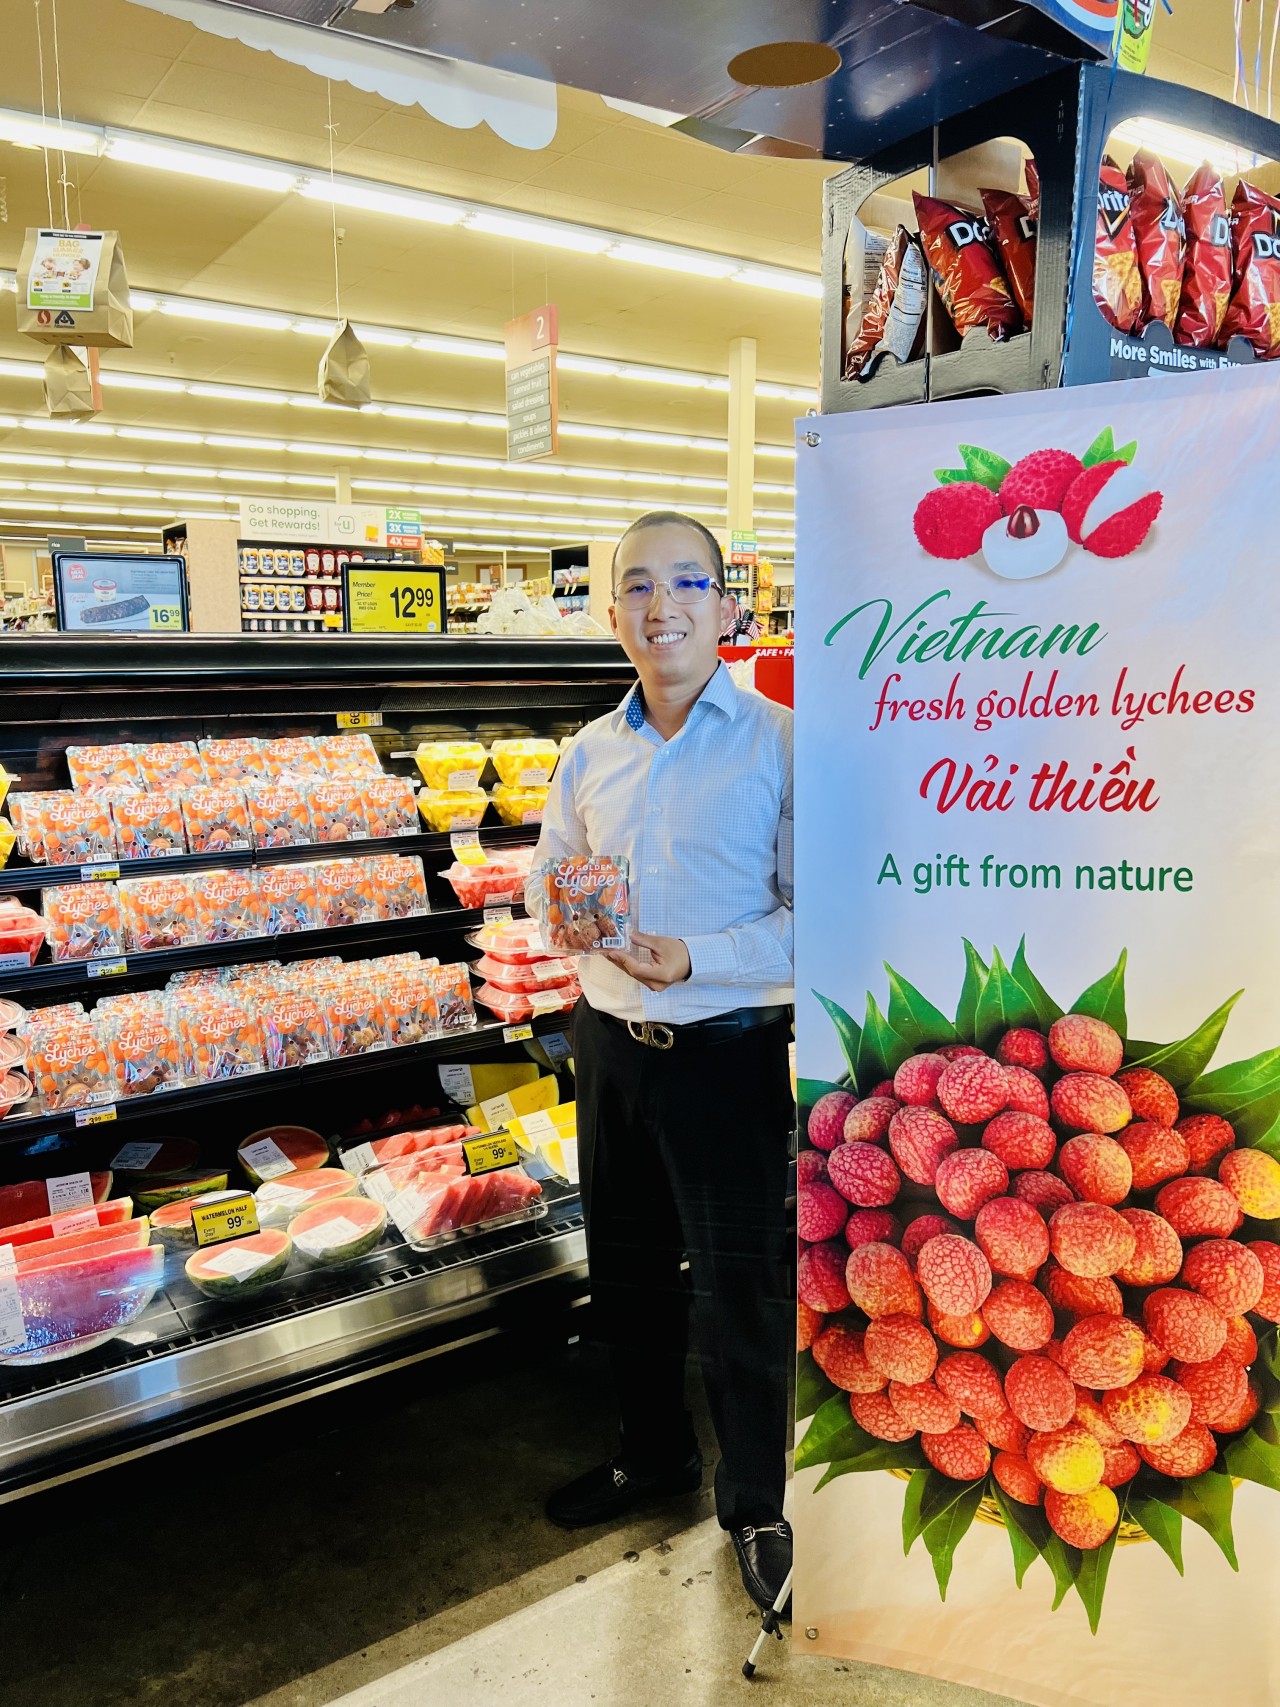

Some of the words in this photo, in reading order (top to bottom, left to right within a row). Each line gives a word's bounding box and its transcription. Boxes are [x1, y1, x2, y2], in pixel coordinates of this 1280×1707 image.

[59, 240, 80, 248] BAG
[536, 316, 545, 341] 2
[1110, 338, 1146, 362] More
[1149, 345, 1197, 370] Smiles
[1199, 358, 1216, 369] with
[511, 371, 520, 381] can
[520, 362, 546, 379] vegetables
[513, 384, 530, 395] canned
[531, 378, 542, 389] fruit
[511, 399, 524, 411] salad
[524, 394, 545, 408] dressing
[522, 412, 537, 423] soups
[512, 430, 529, 443] pickles
[534, 424, 548, 435] olives
[517, 440, 545, 455] condiments
[248, 504, 264, 514] Go
[267, 505, 320, 520] shopping.
[389, 510, 401, 520] 2X
[249, 518, 268, 528] Get
[271, 519, 320, 531] Rewards!
[389, 523, 402, 533] 3X
[389, 536, 403, 546] 4X
[733, 532, 743, 540] 2X
[733, 543, 743, 551] 3X
[732, 554, 743, 562] 4X
[823, 589, 1109, 681] Vietnam
[755, 649, 778, 657] SAFE
[868, 672, 966, 731] fresh
[973, 669, 1100, 731] golden
[1111, 664, 1256, 731] lychees
[146, 749, 189, 766] Lychee
[210, 745, 252, 761] Lychee
[269, 742, 309, 760] Lychee
[326, 739, 365, 757] Lychee
[78, 751, 125, 768] Lychee
[919, 754, 1019, 815] Vải
[1028, 745, 1160, 814] thiều
[192, 793, 236, 815] Lychee
[257, 792, 298, 814] Lychee
[316, 786, 355, 808] Lychee
[368, 784, 406, 804] Lychee
[50, 805, 99, 826] Lychee
[124, 799, 170, 821] Lychee
[322, 869, 364, 891] Lychee
[377, 863, 415, 885] Lychee
[554, 864, 616, 897] Lychee
[877, 854, 902, 886] A
[913, 854, 970, 894] gift
[980, 855, 1061, 889] from
[1075, 859, 1193, 892] nature
[204, 882, 250, 904] Lychee
[262, 875, 307, 898] Lychee
[59, 895, 109, 919] Lychee
[138, 886, 186, 909] Lychee
[436, 969, 459, 978] GOLDEN
[334, 995, 376, 1019] Lychee
[390, 988, 427, 1010] Lychee
[272, 1003, 317, 1028] Lychee
[200, 1015, 247, 1038] Lychee
[118, 1031, 167, 1056] Lychee
[44, 1043, 96, 1067] Lychee
[201, 1208, 235, 1221] WATERMELON
[236, 1204, 248, 1213] HALF
